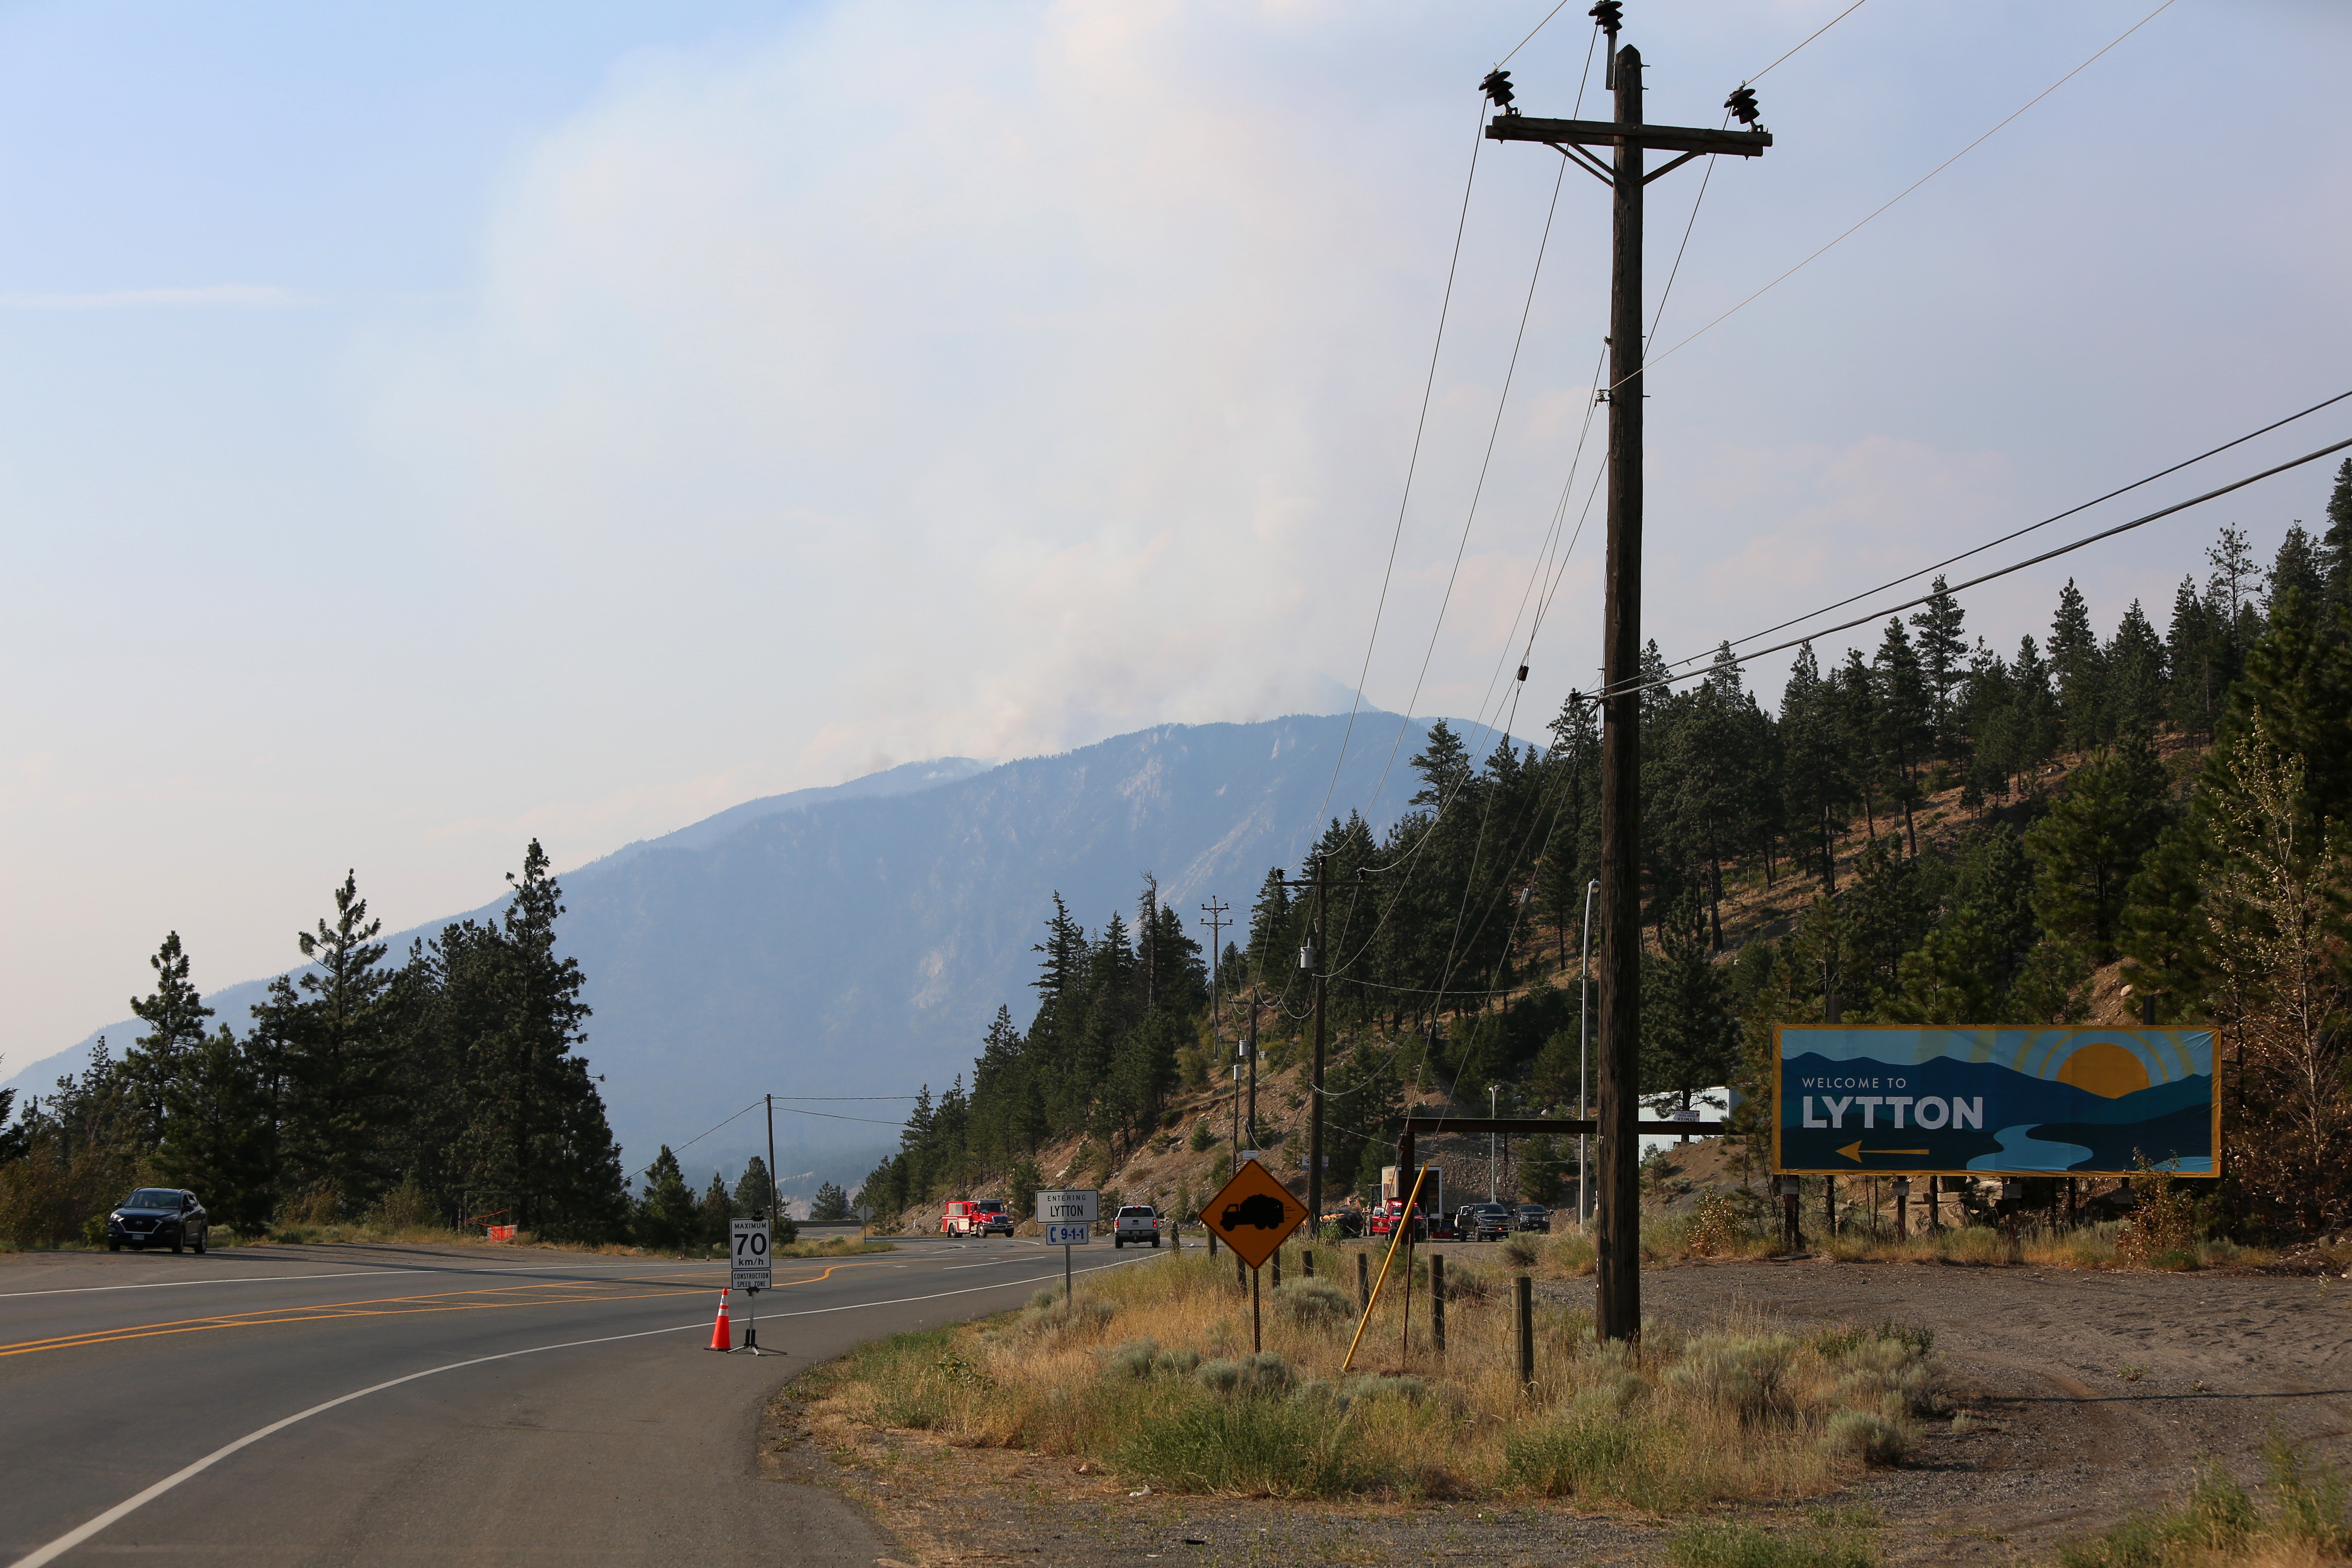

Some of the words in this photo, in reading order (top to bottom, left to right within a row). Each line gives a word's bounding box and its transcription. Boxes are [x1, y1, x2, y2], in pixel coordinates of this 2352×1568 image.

[1802, 1078, 1878, 1088] WELCOME
[1887, 1078, 1906, 1088] TO
[1803, 1096, 1983, 1129] LYTTON
[1050, 1205, 1083, 1217] LYTTON
[1061, 1227, 1084, 1240] 9-1-1
[734, 1232, 767, 1256] 70
[739, 1258, 764, 1266] km/h
